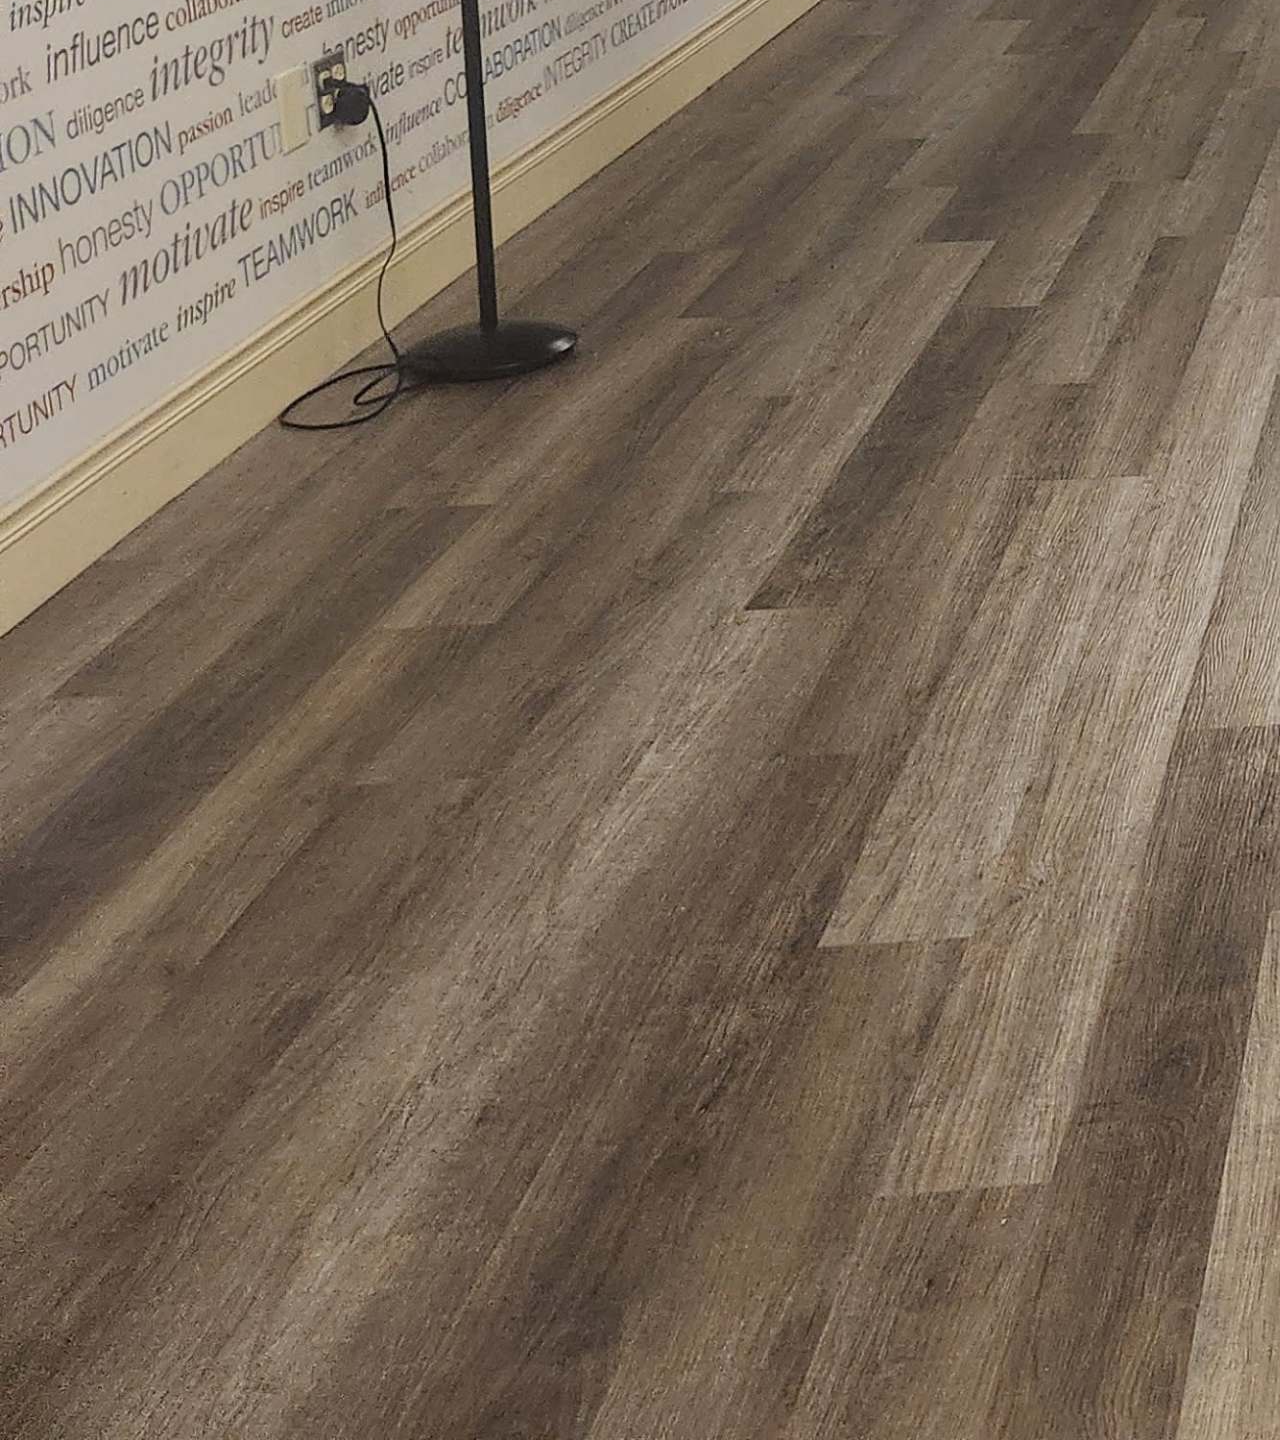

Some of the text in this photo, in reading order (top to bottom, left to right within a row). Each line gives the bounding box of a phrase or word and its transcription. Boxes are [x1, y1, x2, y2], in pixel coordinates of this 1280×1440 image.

[46, 12, 159, 83] influence
[66, 87, 144, 139] diligence
[150, 15, 274, 102] integrity
[281, 6, 323, 39] create
[10, 121, 172, 235] INNOVATION
[178, 106, 233, 155] passion
[88, 320, 168, 392] motivate
[177, 278, 236, 334] inspire
[239, 189, 358, 287] TEAMWORK
[543, 33, 606, 92] INTEGRITY
[611, 1, 657, 48] CREATE
[119, 198, 253, 305] motivate
[259, 179, 305, 220] inspire
[307, 134, 378, 187] teamwork
[59, 198, 153, 275] honesty
